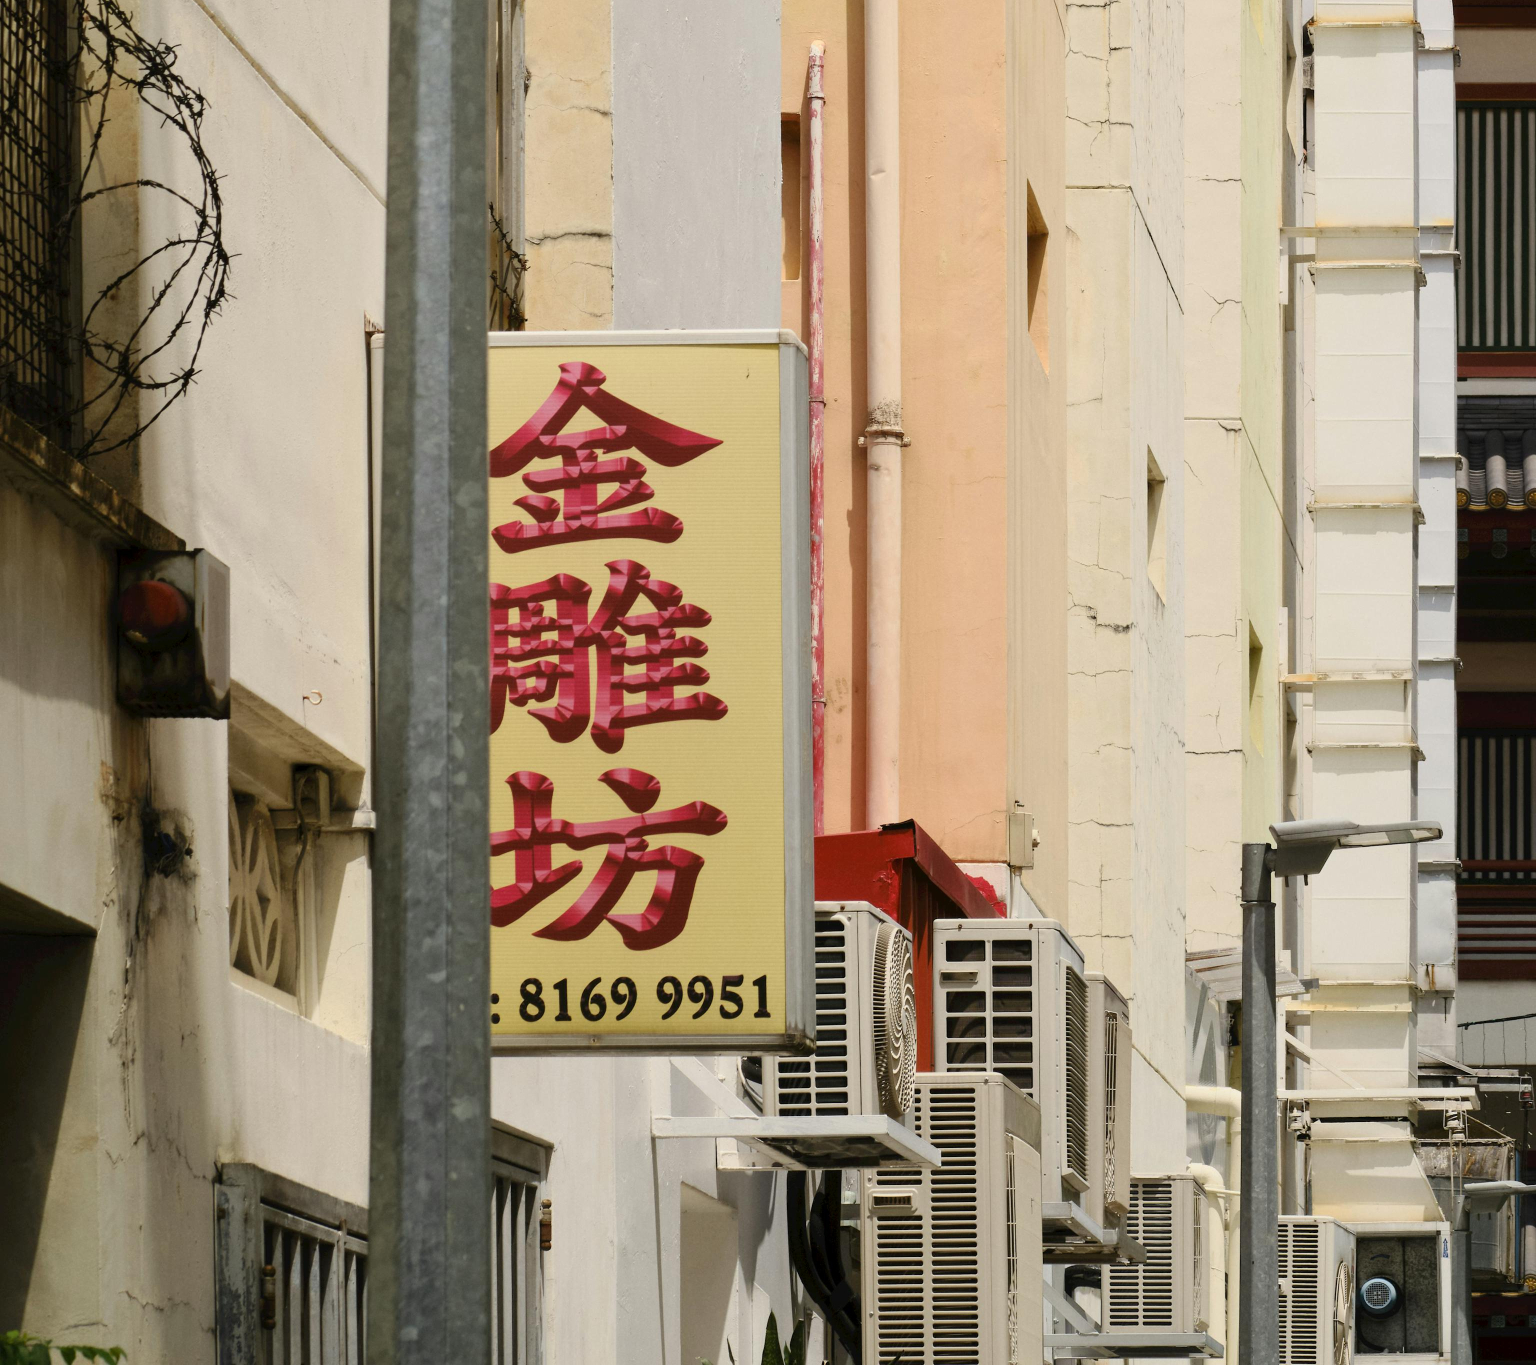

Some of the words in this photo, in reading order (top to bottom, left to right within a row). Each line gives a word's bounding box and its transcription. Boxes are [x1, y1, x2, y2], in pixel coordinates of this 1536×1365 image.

[489, 361, 728, 951] 金雕坊
[519, 977, 637, 1022] 8169
[656, 974, 771, 1020] 9951
